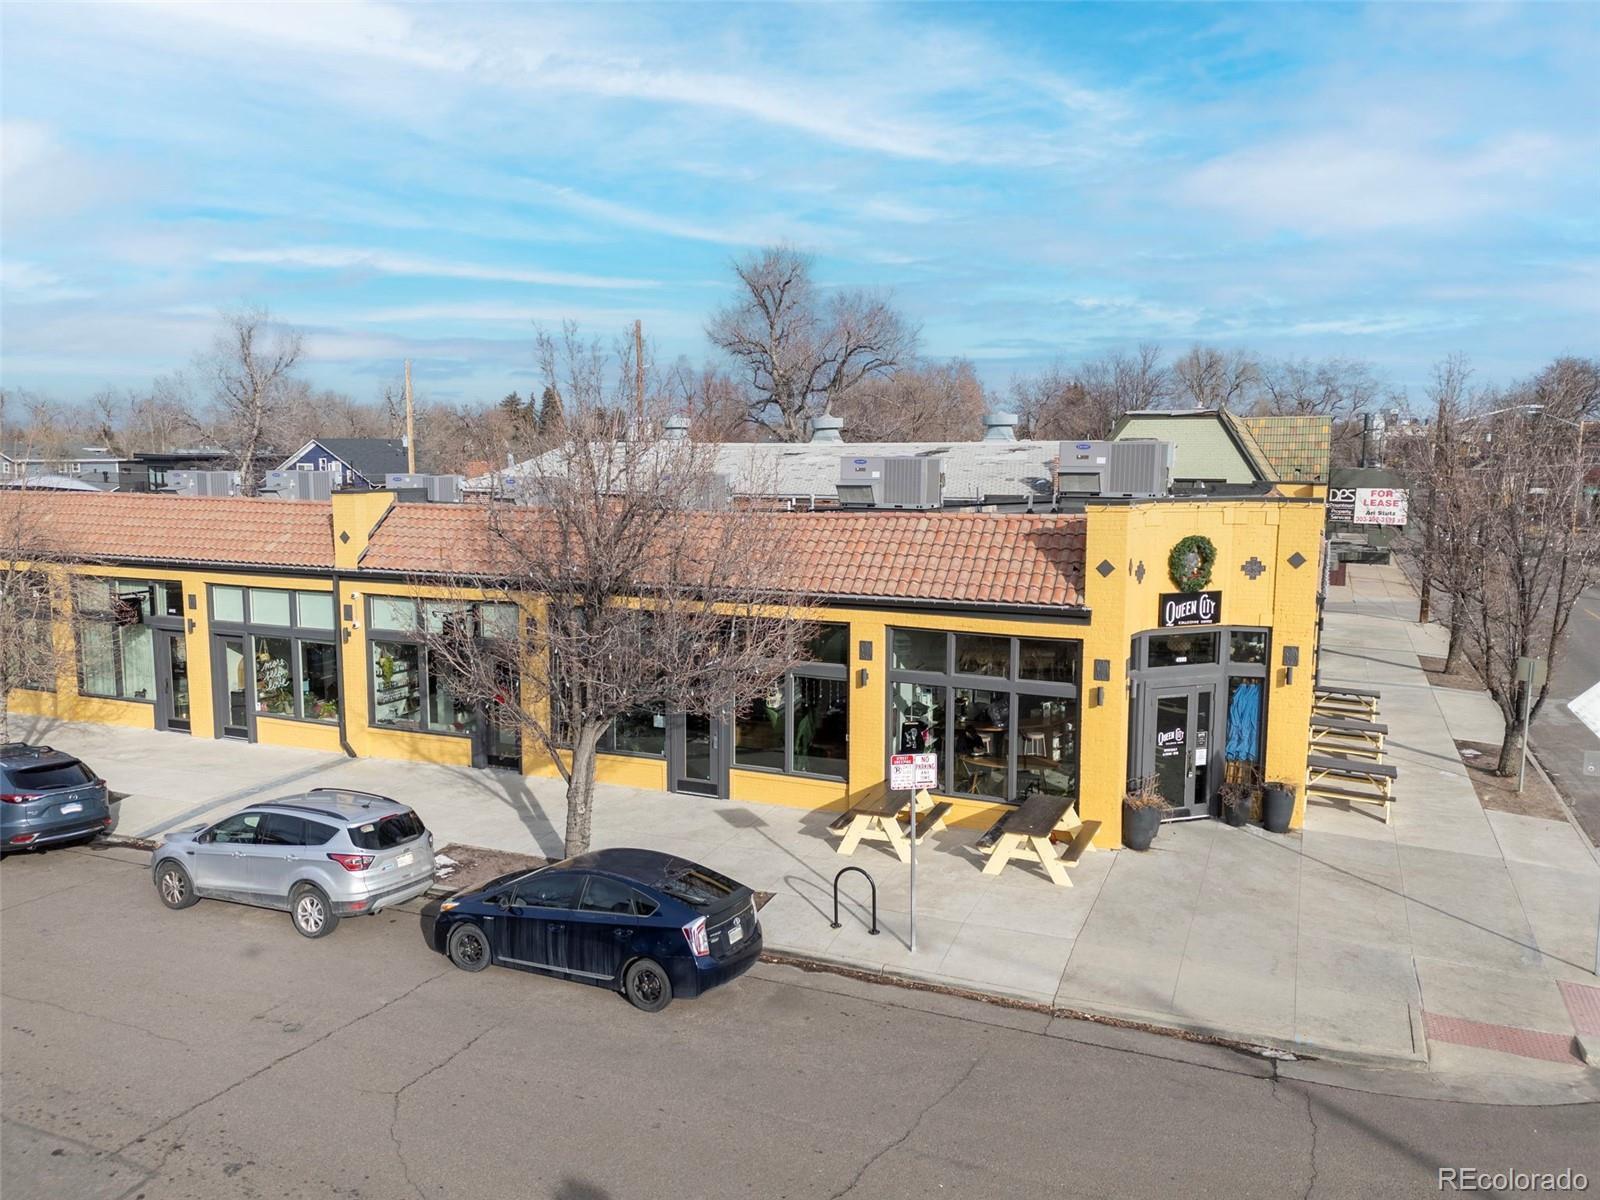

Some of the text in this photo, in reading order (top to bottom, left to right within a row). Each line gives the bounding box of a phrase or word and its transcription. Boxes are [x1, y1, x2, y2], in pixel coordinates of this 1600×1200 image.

[1370, 490, 1393, 498] FOR
[1165, 594, 1217, 627] QUEEN CITY
